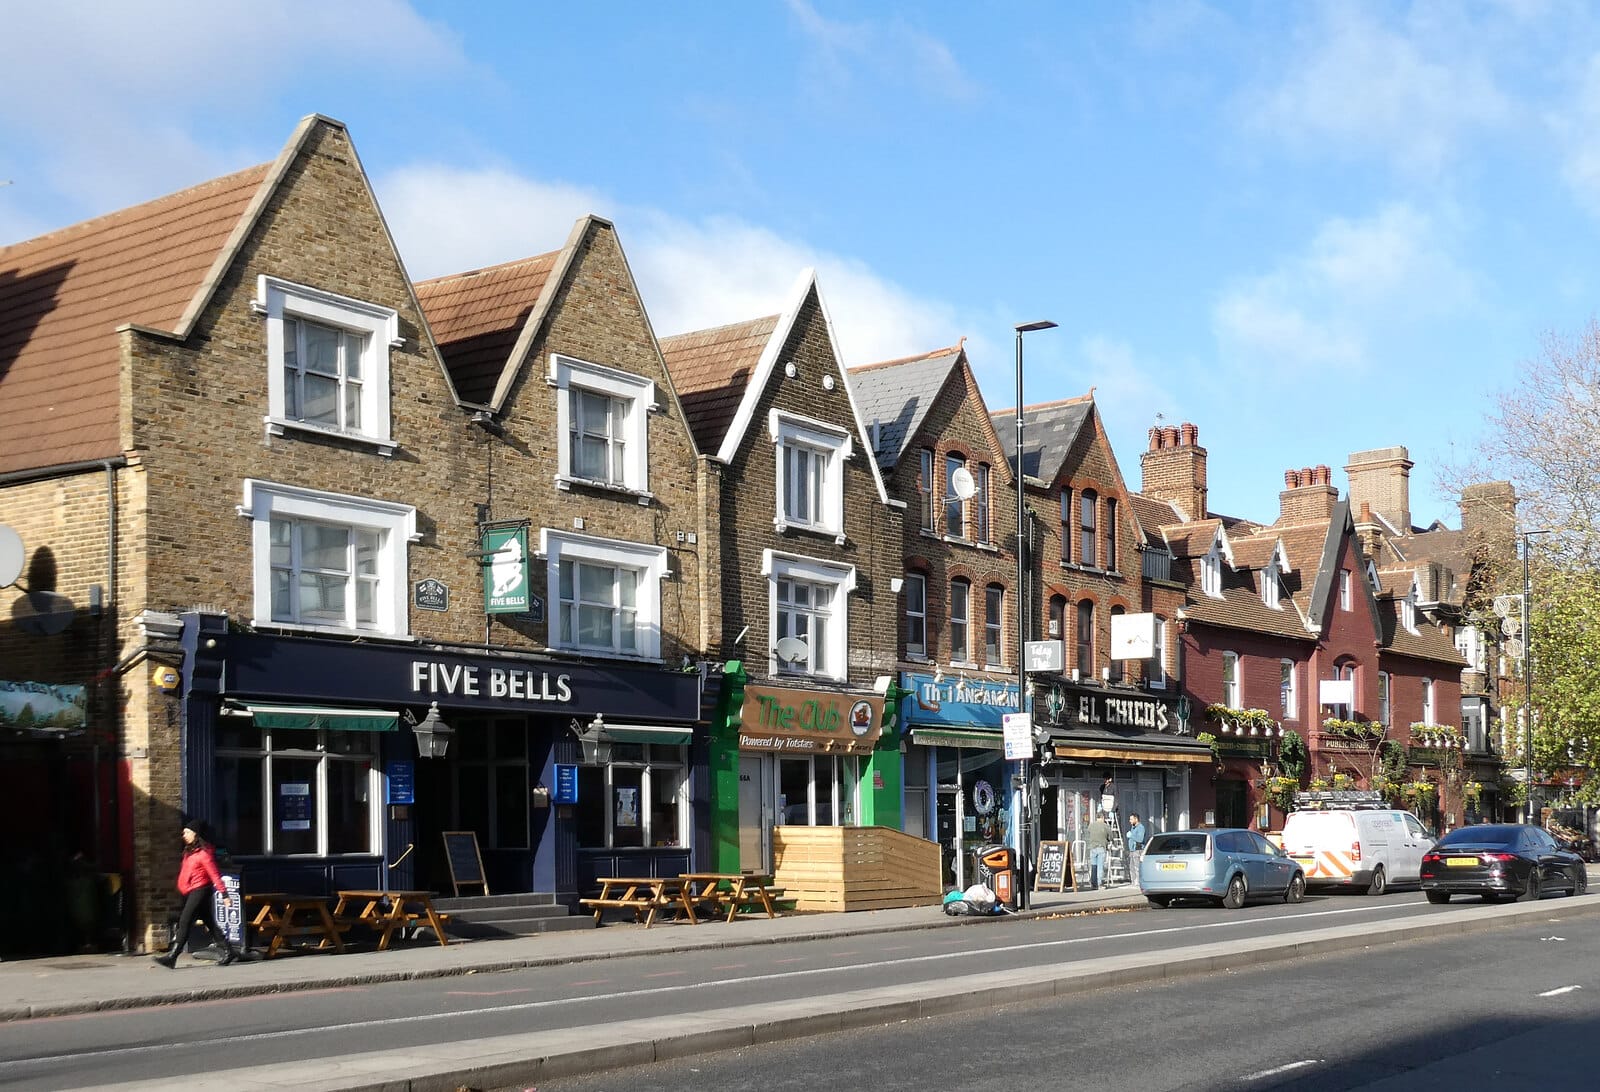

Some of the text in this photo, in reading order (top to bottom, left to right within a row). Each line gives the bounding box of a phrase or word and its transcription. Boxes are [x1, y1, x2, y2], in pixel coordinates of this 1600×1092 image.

[491, 596, 525, 606] FIVE BELLS
[412, 661, 572, 702] FIVE BELLS
[757, 694, 841, 732] The Club
[1078, 695, 1169, 732] EL CHICO'S
[741, 735, 773, 747] Powered
[774, 736, 785, 750] by
[786, 737, 814, 749] Totstars
[1325, 740, 1349, 749] PUBLIC
[1042, 852, 1064, 862] LUNCH
